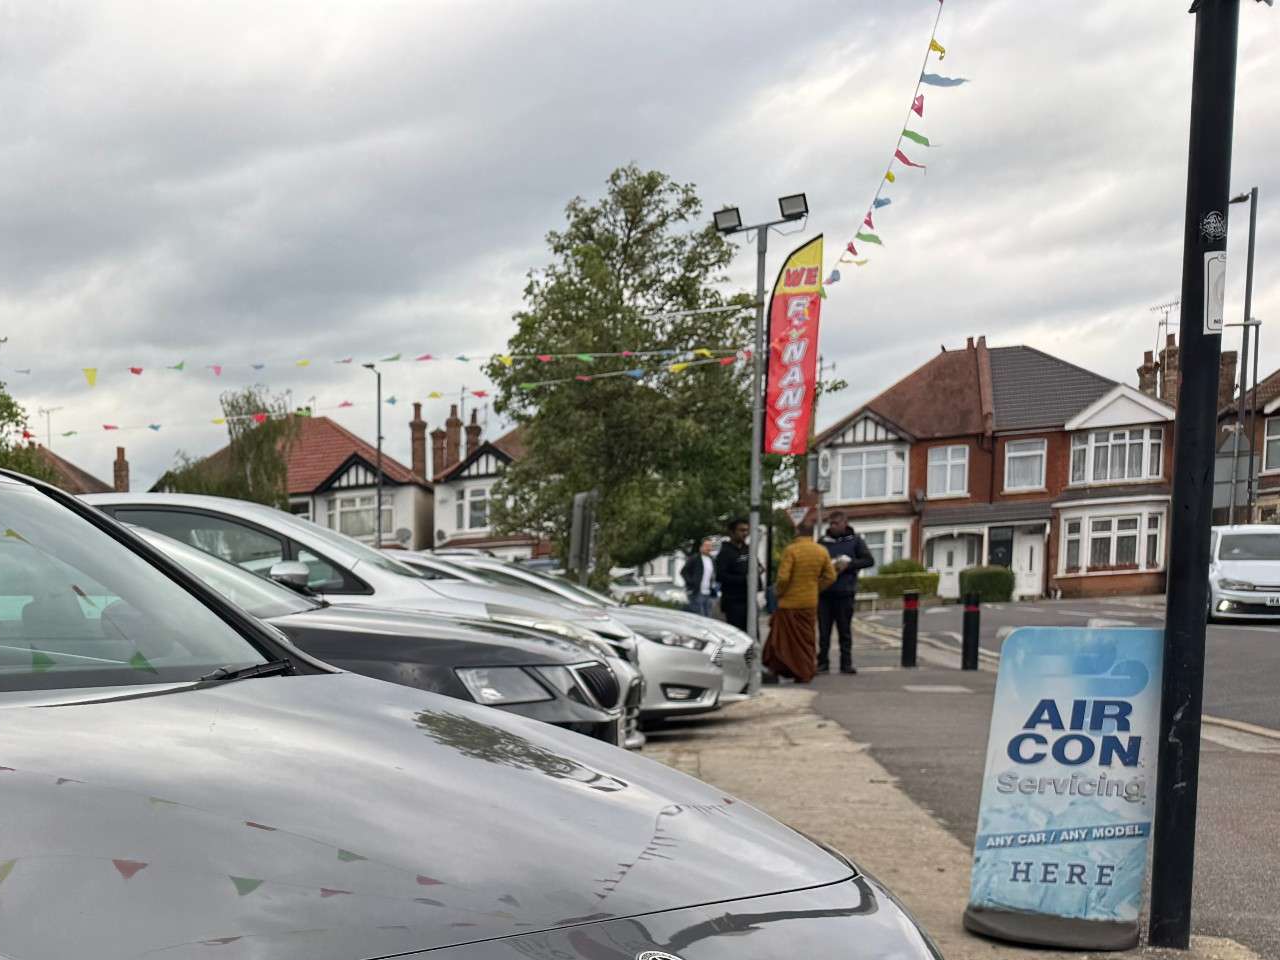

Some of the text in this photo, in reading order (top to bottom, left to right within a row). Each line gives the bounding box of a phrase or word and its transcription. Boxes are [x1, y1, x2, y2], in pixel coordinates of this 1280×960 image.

[784, 267, 818, 288] WE
[773, 296, 810, 450] FNANCE
[1022, 699, 1133, 732] AIR
[1007, 733, 1142, 768] CON
[996, 771, 1146, 802] Servicing
[986, 836, 1015, 848] ANY
[1017, 833, 1048, 844] CAR
[1059, 829, 1088, 842] ANY
[1092, 824, 1144, 838] MODEL
[1009, 861, 1116, 886] HERE
